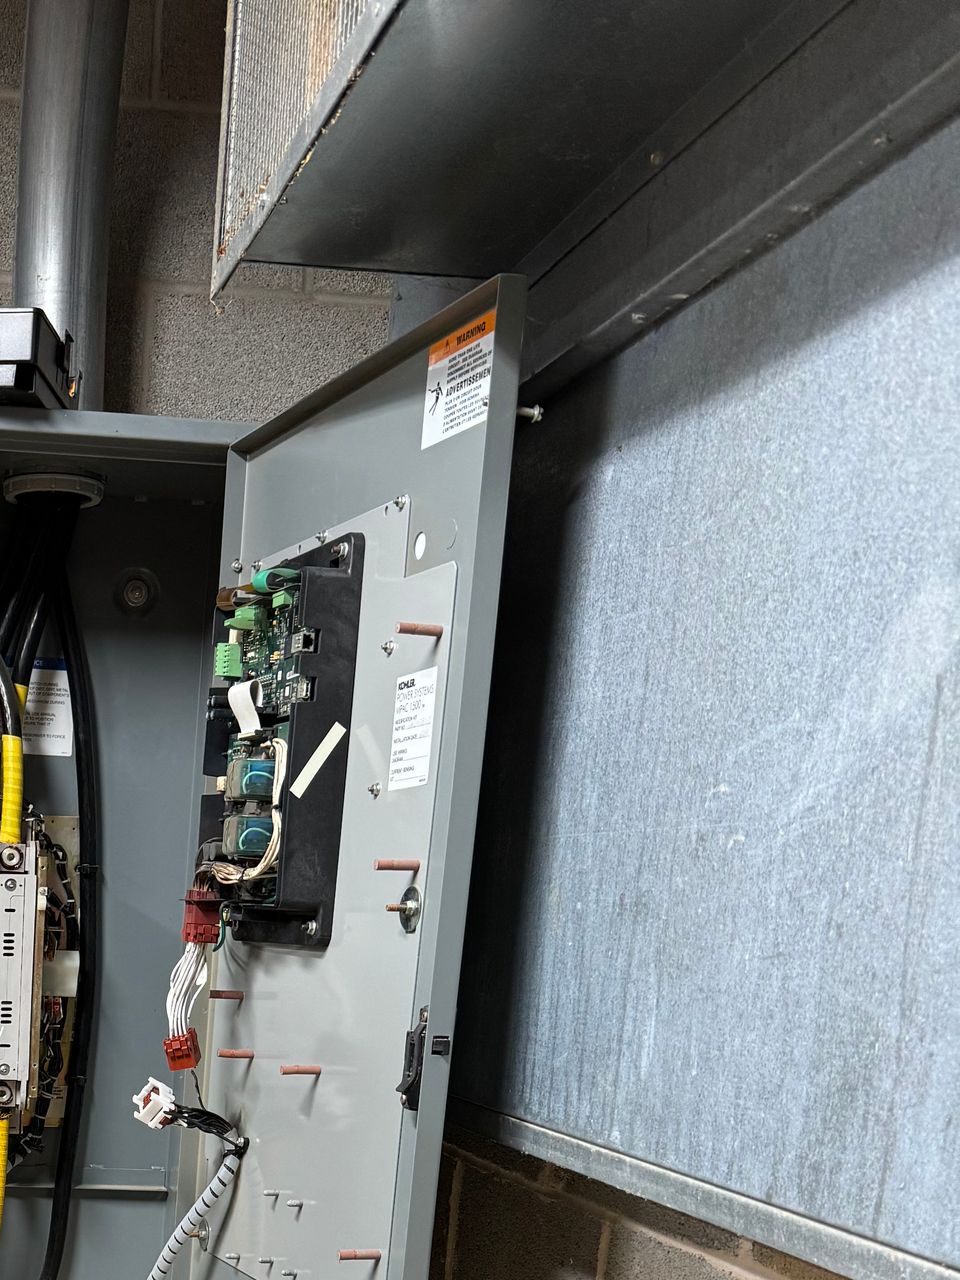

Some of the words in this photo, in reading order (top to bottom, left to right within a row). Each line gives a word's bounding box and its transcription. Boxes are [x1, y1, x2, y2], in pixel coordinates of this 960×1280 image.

[456, 321, 486, 346] WARNING
[458, 368, 470, 378] BEFORE
[398, 678, 416, 691] KOHLER
[397, 690, 413, 702] POWER
[414, 684, 434, 698] SYSTEMS
[410, 699, 421, 712] 1500
